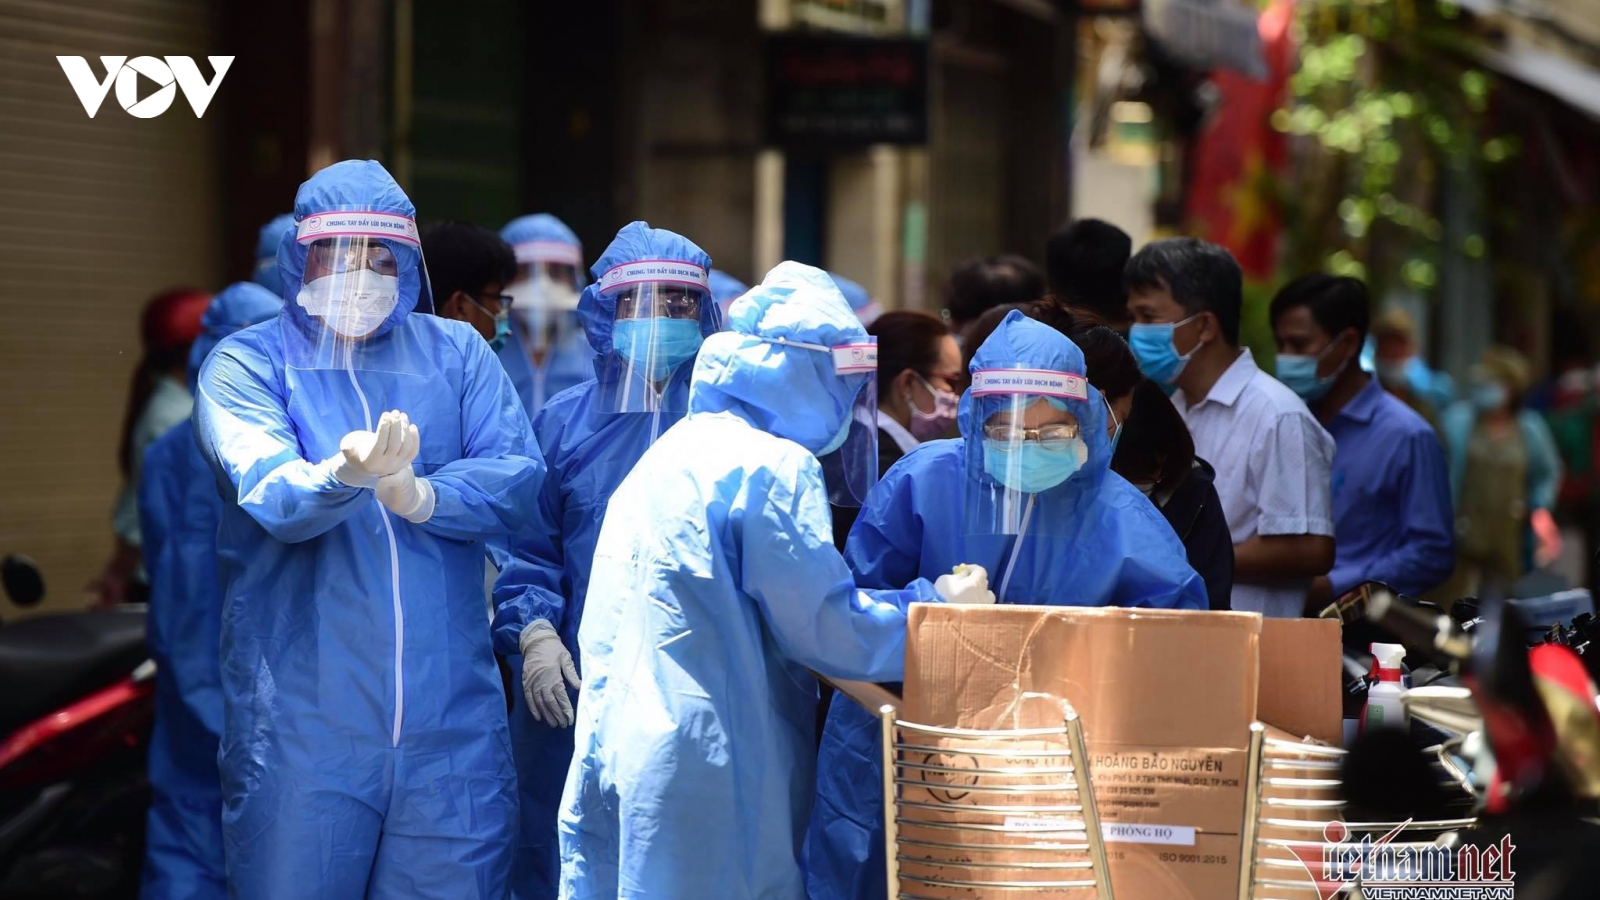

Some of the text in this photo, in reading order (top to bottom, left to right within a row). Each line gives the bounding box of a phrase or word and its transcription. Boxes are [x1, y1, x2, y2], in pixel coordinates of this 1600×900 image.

[1096, 753, 1138, 769] HOÀNG
[1142, 752, 1168, 770] BẢO
[1171, 755, 1222, 773] NGUYÊN
[1110, 824, 1173, 840] PHÒNG HỘ
[1159, 852, 1177, 862] ISO
[1179, 853, 1227, 864] 9001:2015
